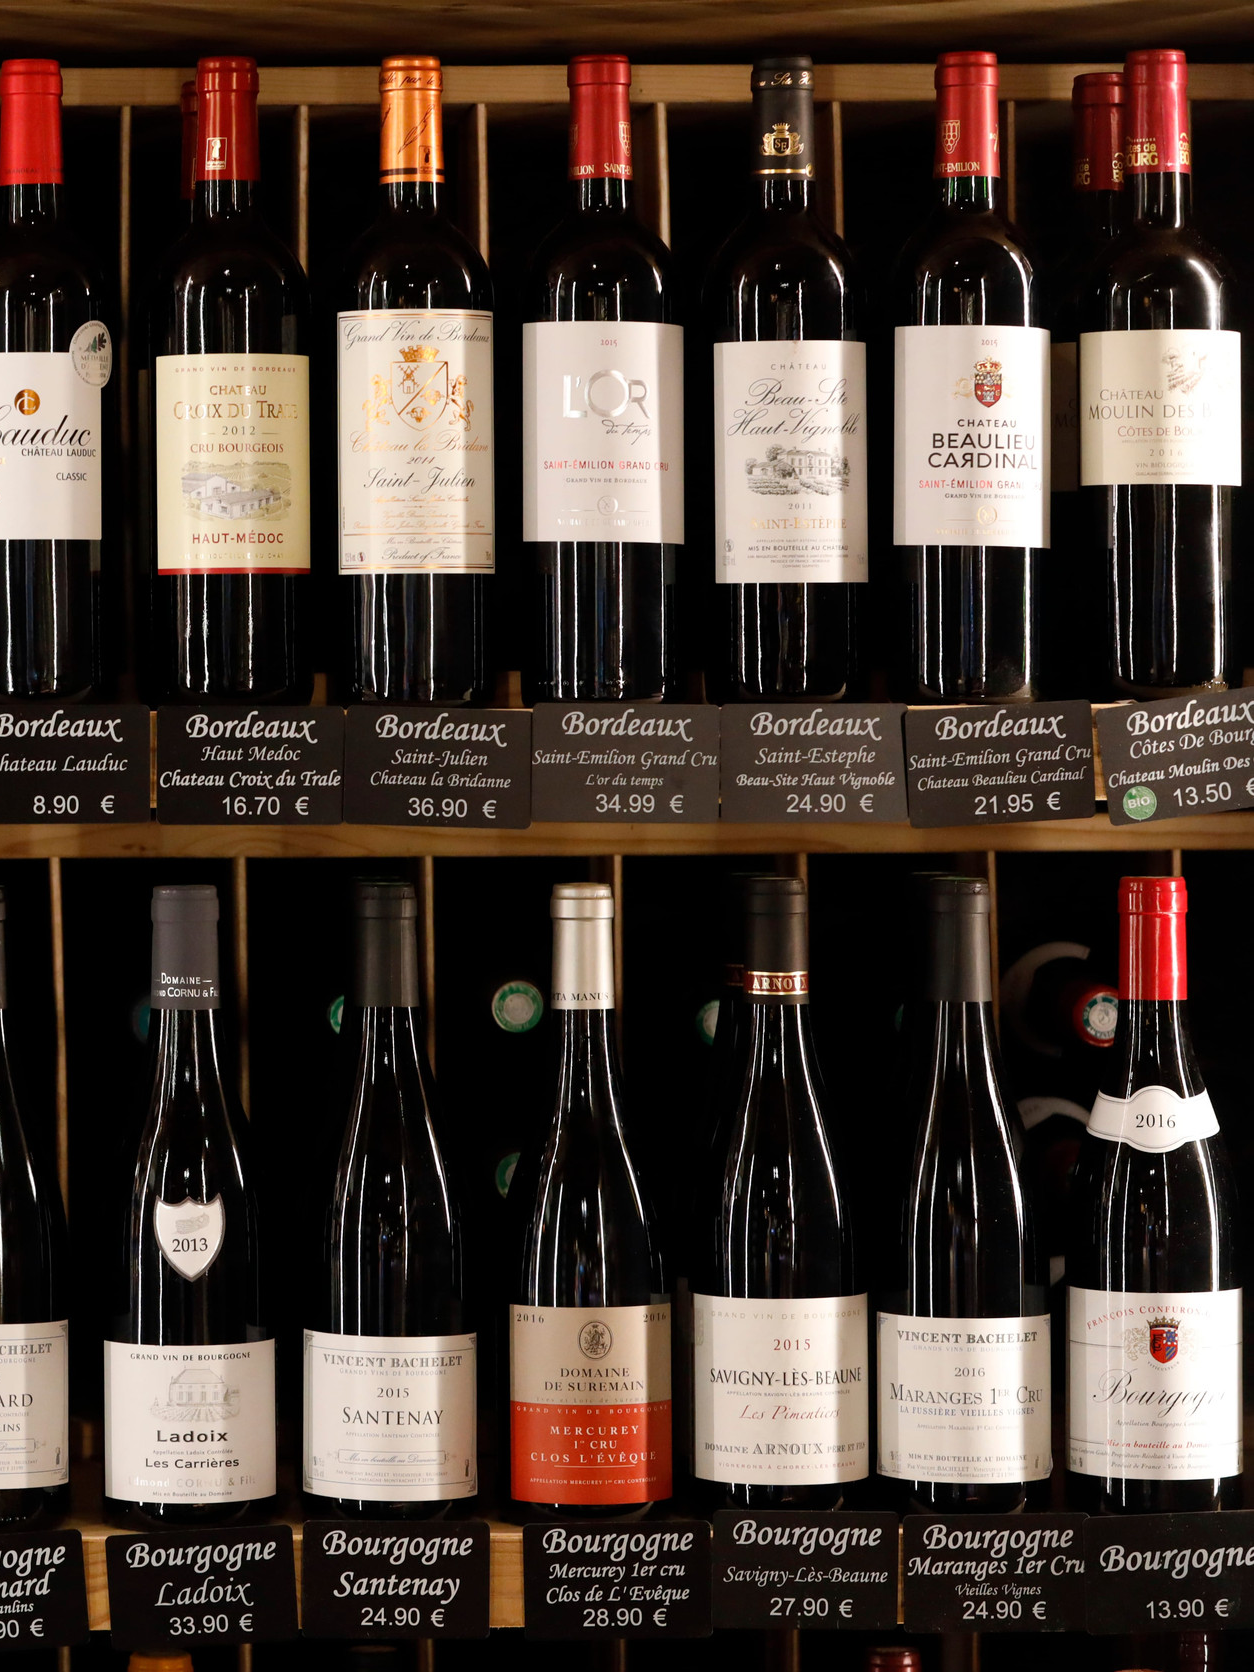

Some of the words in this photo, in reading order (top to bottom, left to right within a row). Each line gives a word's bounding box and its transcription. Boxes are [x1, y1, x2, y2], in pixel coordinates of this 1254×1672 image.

[1100, 389, 1163, 401] CHÂTEAU
[1089, 404, 1153, 420] MOULIN
[1163, 405, 1194, 418] DES
[957, 419, 1016, 428] CHATEAU
[933, 433, 1035, 449] BEAULIEU
[544, 459, 614, 469] SAINT-ÉMILION
[619, 461, 650, 470] GRAND
[919, 478, 992, 489] SAINT-ÉMILION
[186, 711, 317, 743] Bordeaux
[376, 713, 507, 747] Bordeaux
[751, 709, 882, 740] Bordeaux
[201, 746, 243, 760] Haut
[248, 744, 300, 761] Medoc
[391, 749, 487, 767] Saint-Julien
[755, 745, 875, 768] Saint-Estephe
[62, 753, 127, 771] Lauduc
[160, 770, 224, 787] Chateau
[230, 771, 273, 789] Croix
[276, 770, 295, 786] du
[301, 770, 341, 786] Trale
[371, 770, 426, 785] Chateau
[431, 772, 443, 786] la
[448, 773, 511, 788] Bridanne
[737, 774, 798, 786] Beau-Site
[801, 773, 835, 785] Haut
[839, 772, 895, 789] Vignoble
[34, 796, 79, 814] 8.90
[101, 795, 114, 813] €
[223, 797, 280, 815] 16.70
[295, 797, 309, 815] €
[409, 798, 467, 817] 36.90
[483, 800, 496, 818] €
[787, 794, 845, 812] 24.90
[860, 794, 873, 812] €
[162, 973, 200, 984] DOMAINE
[1136, 1114, 1175, 1128] 2016
[172, 1237, 208, 1254] 2013
[774, 1339, 810, 1351] 2015
[198, 1352, 250, 1361] BOURGOGNE
[324, 1354, 386, 1367] VINCENT
[391, 1356, 462, 1368] BACHELET
[561, 1368, 628, 1378] DOMAINE
[711, 1367, 860, 1386] SAVIGNY-LÈS-BEAUNE
[377, 1388, 409, 1398] 2015
[545, 1381, 562, 1391] DE
[568, 1381, 643, 1391] SUREMAIN
[343, 1407, 443, 1425] SANTENAY
[739, 1404, 766, 1420] Les
[772, 1405, 839, 1420] Pimentiers
[157, 1430, 227, 1442] Ladoix
[146, 1458, 168, 1468] Les
[175, 1457, 239, 1468] Carrières
[543, 1529, 693, 1561] Bourgogne
[923, 1525, 1073, 1558] Bourgogne
[549, 1564, 625, 1582] Mercurey
[632, 1563, 657, 1576] 1er
[660, 1565, 685, 1576] cru
[908, 1557, 1007, 1581] Maranges
[1015, 1555, 1046, 1573] 1er
[1051, 1556, 1084, 1575] Cru
[547, 1585, 580, 1604] Clos
[585, 1585, 603, 1601] de
[955, 1583, 998, 1595] Vieilles
[1002, 1583, 1041, 1599] Vignes
[584, 1608, 642, 1626] 28.90
[653, 1609, 666, 1626] €
[963, 1601, 1021, 1619] 24.90
[1033, 1601, 1046, 1619] €
[30, 1619, 43, 1636] €
